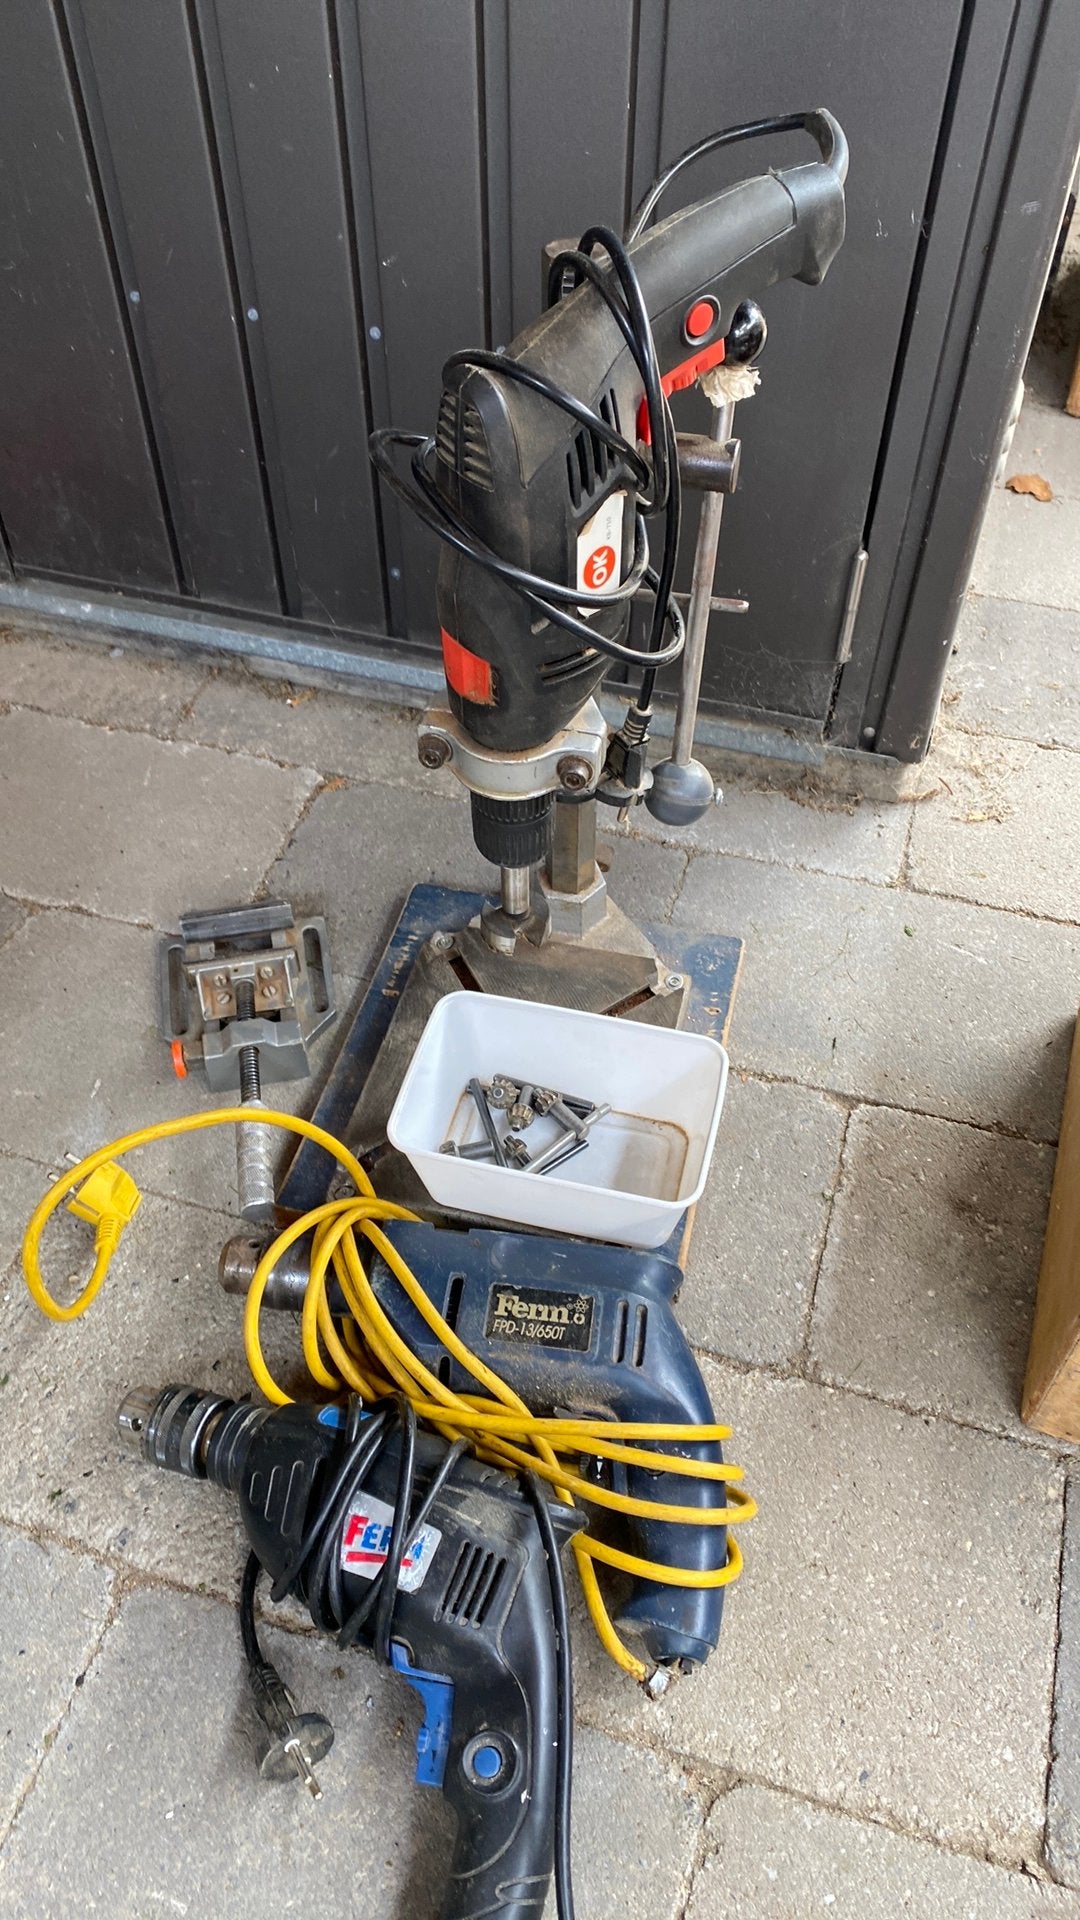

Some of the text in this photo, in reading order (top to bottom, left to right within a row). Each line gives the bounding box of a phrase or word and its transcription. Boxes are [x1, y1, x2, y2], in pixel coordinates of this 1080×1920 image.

[592, 548, 609, 586] OK
[494, 1293, 569, 1324] Ferm
[492, 1319, 566, 1340] FPD-13/650T
